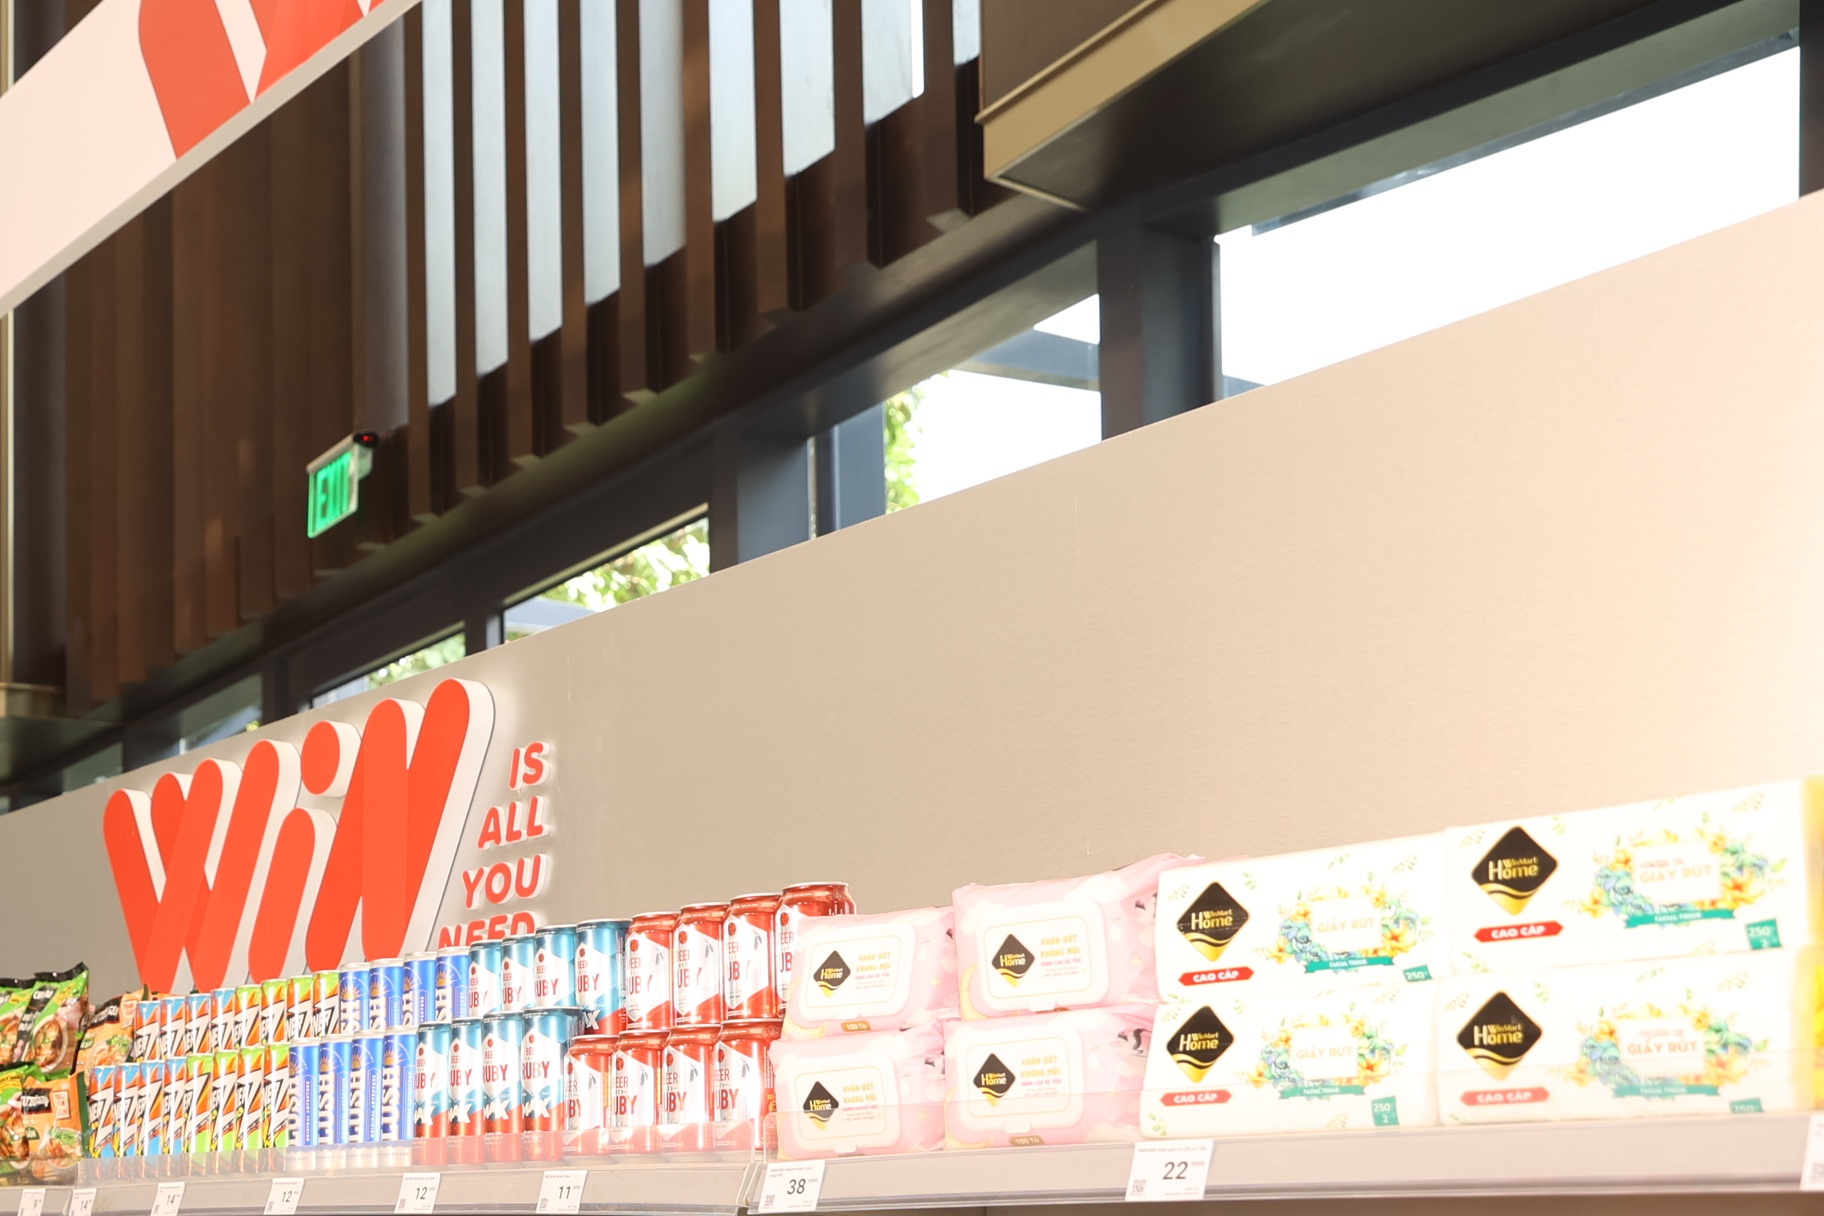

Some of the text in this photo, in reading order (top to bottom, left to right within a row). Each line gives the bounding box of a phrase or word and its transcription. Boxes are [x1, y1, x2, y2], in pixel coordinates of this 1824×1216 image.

[509, 742, 544, 789] IS
[478, 796, 544, 849] ALL
[1488, 860, 1539, 881] Home
[463, 854, 541, 909] YOU
[1491, 927, 1518, 939] CAO
[1193, 973, 1216, 982] CAO
[1174, 1094, 1195, 1103] CAO
[1163, 1160, 1189, 1181] 22
[414, 1184, 429, 1201] 12
[787, 1178, 806, 1196] 38
